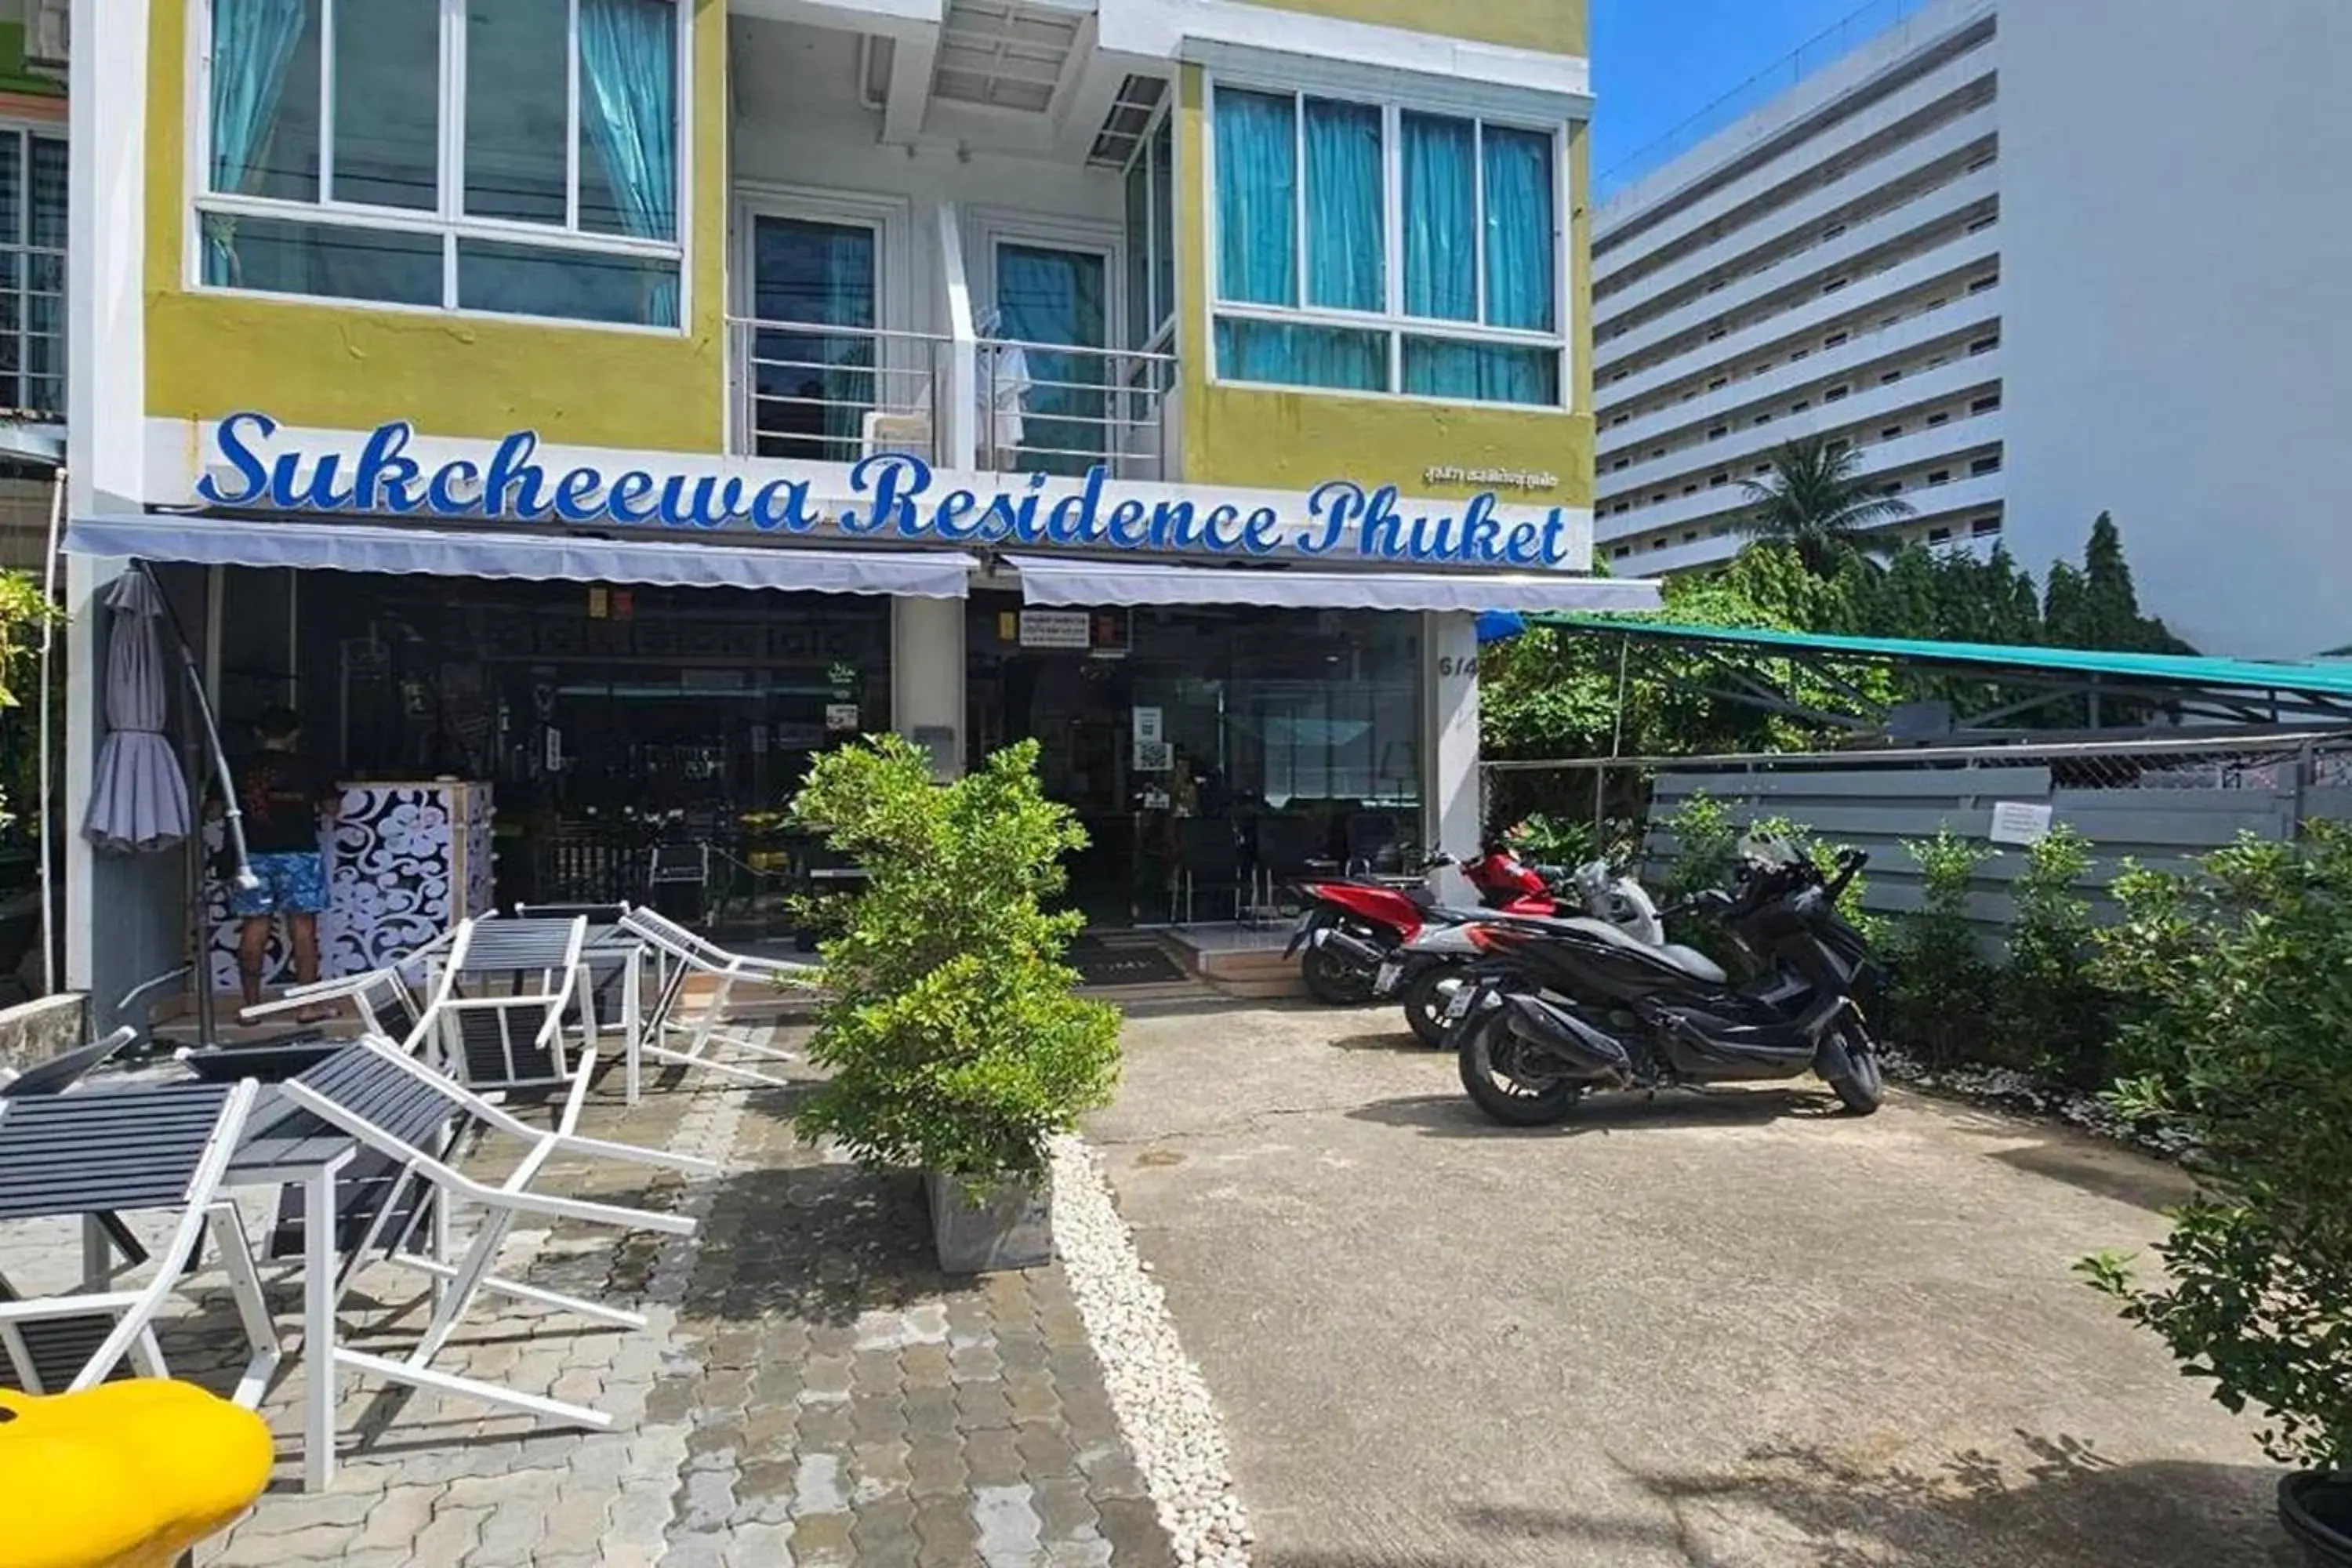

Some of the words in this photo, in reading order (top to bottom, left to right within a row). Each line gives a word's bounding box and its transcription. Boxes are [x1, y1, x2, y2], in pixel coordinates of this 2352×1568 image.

[196, 412, 818, 535] Sukcheewa
[840, 452, 1282, 554] Residence
[1298, 479, 1568, 565] Phuket
[1439, 656, 1479, 680] 6/4
